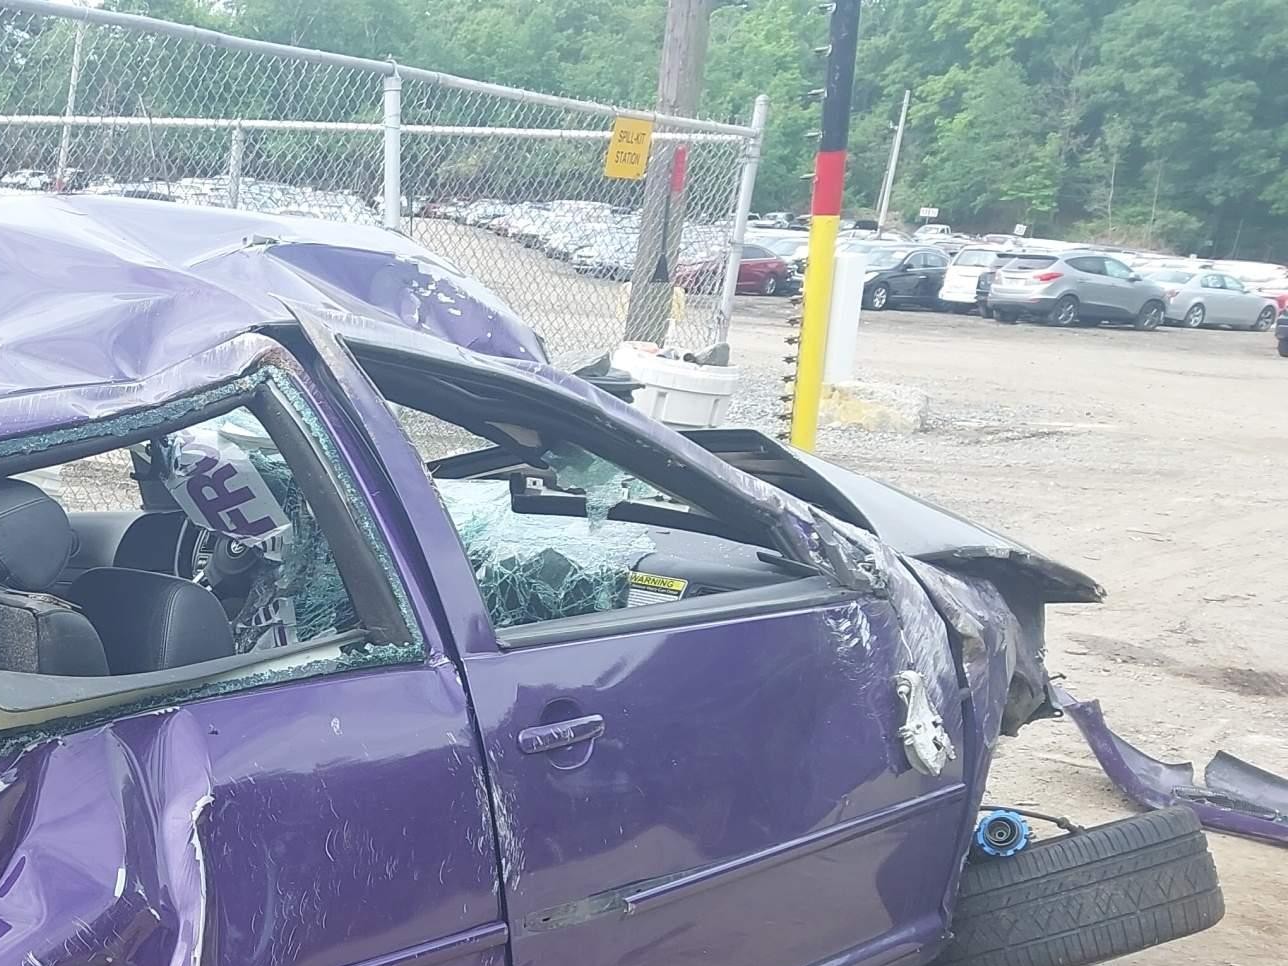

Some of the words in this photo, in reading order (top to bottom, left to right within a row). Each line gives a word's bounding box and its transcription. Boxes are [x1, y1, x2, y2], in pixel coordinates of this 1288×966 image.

[618, 129, 646, 144] SPILL-KIT
[615, 150, 640, 165] STATION
[631, 575, 674, 587] WARNING
